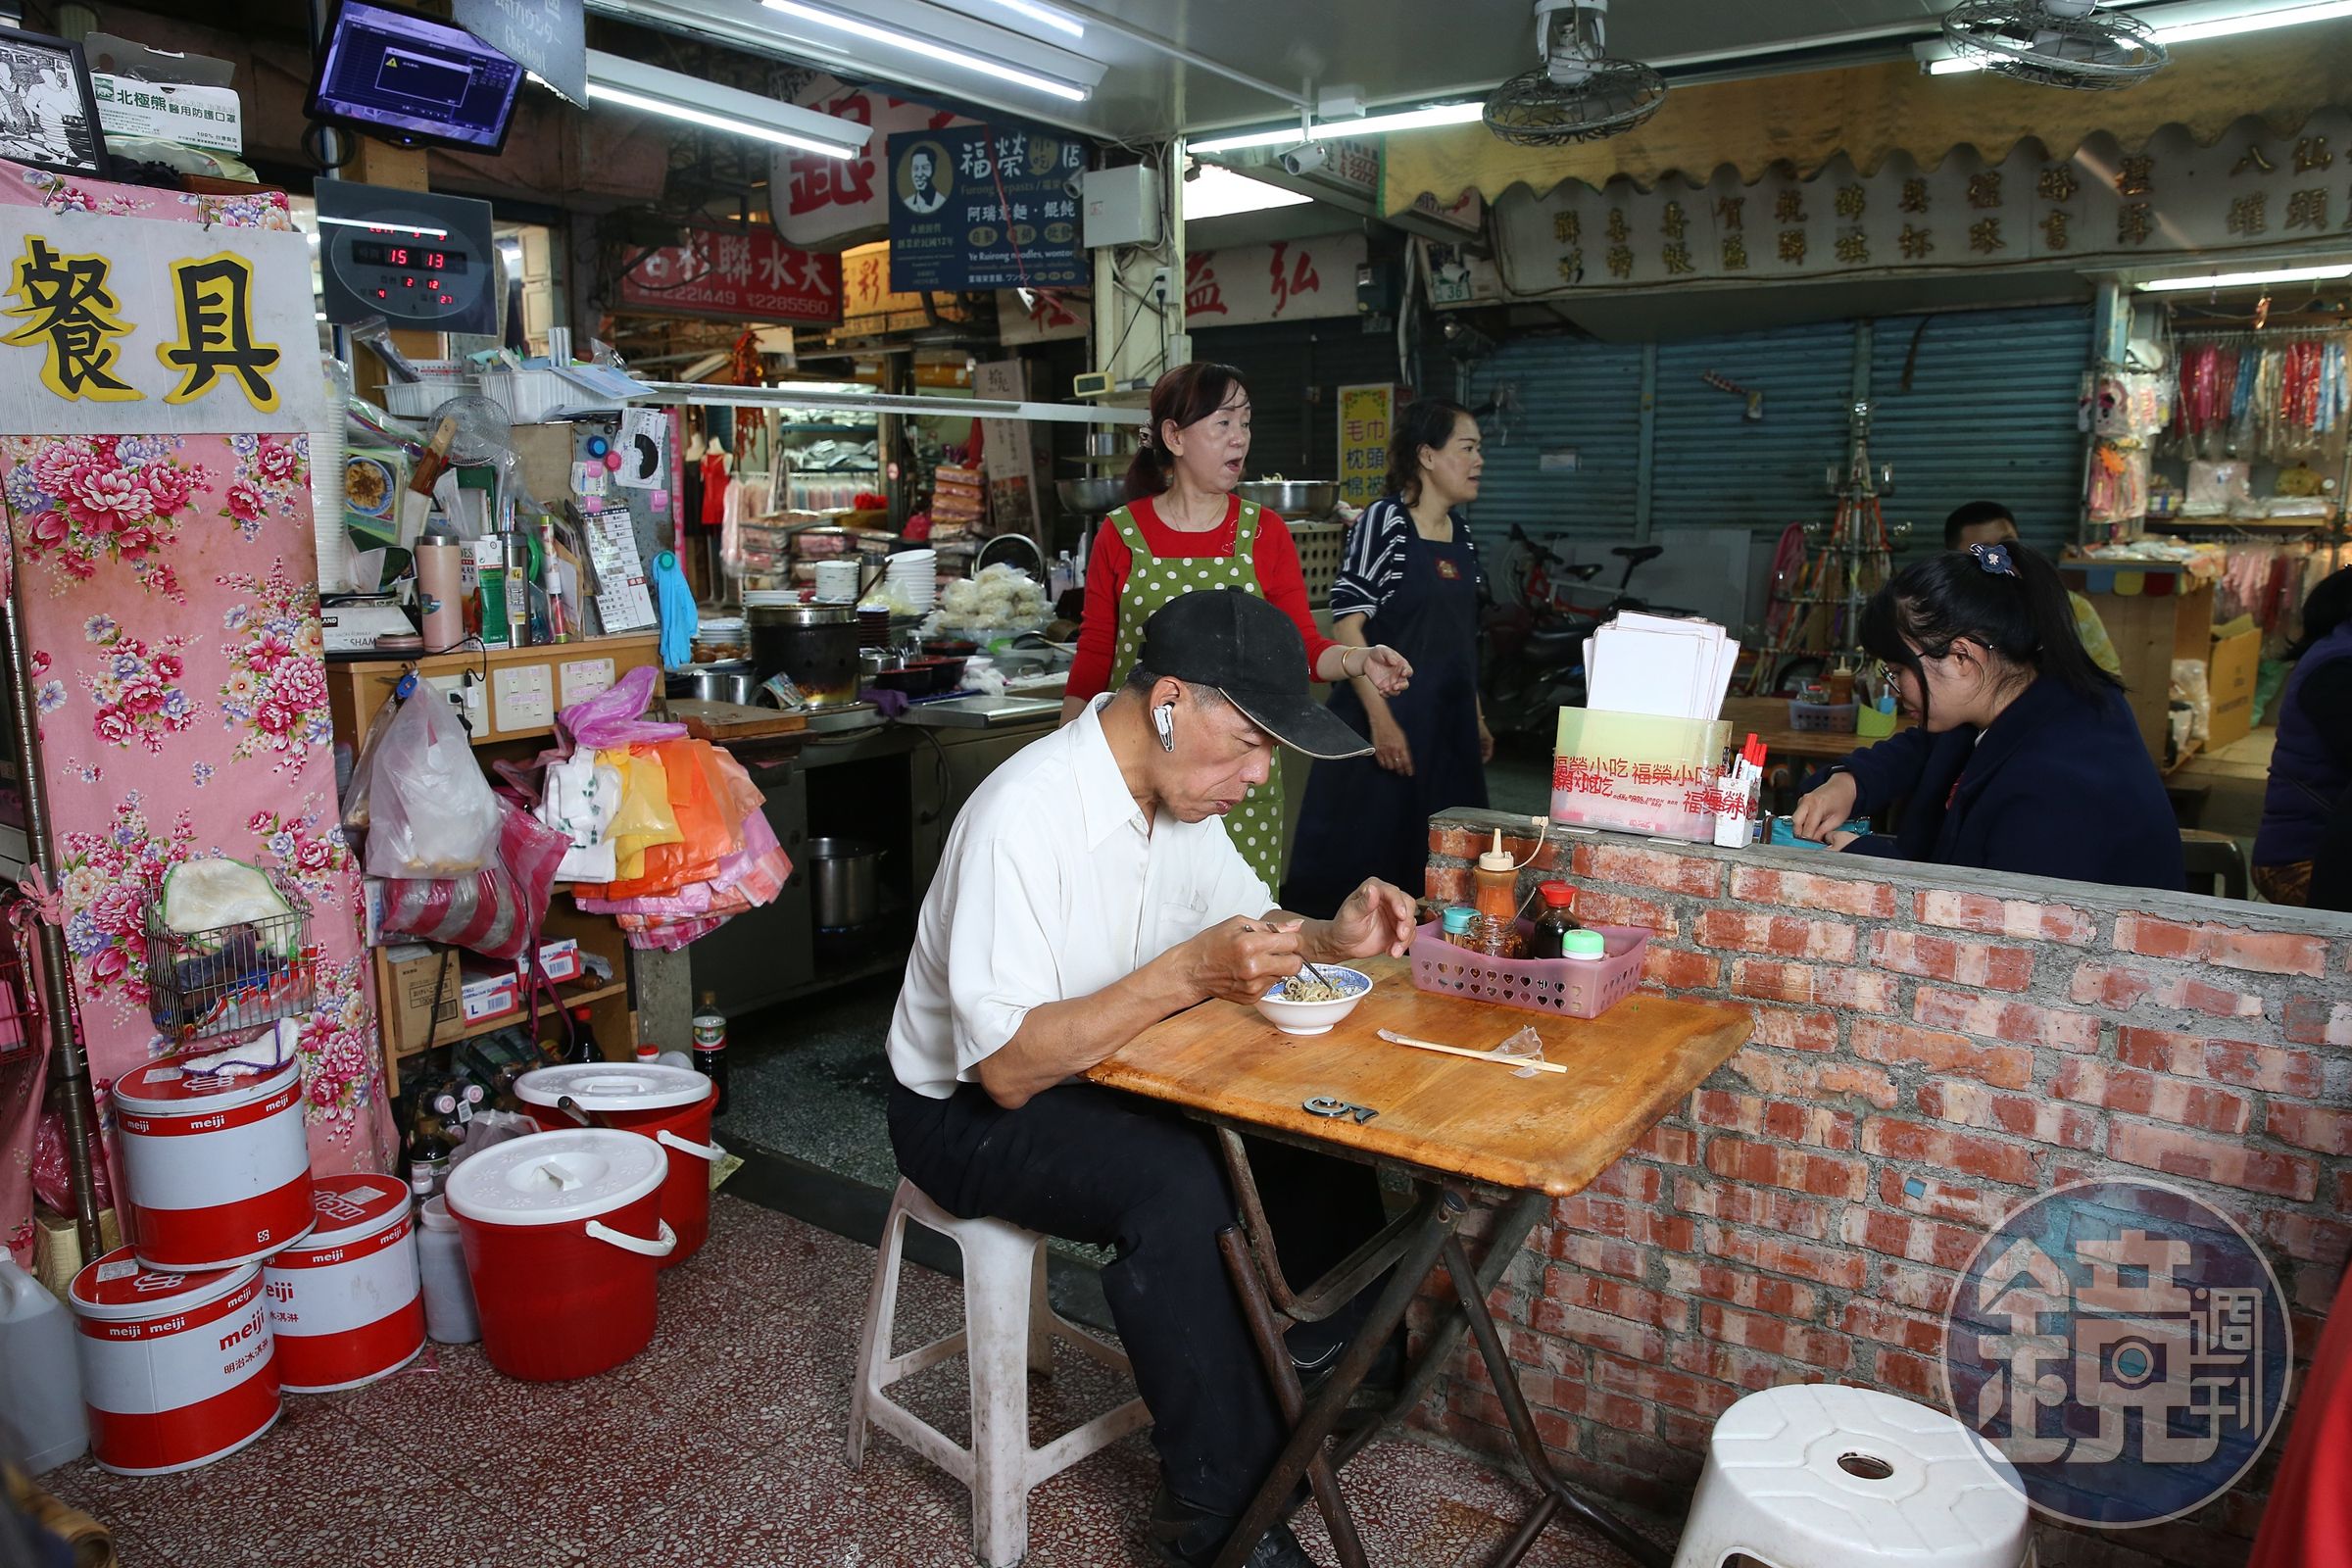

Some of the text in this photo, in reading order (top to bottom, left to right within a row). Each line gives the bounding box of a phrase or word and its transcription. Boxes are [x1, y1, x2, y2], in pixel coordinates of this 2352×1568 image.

[117, 89, 167, 112] 北極熊
[169, 103, 236, 124] 醫用防護口罩
[960, 133, 1027, 178] 福榮
[391, 249, 445, 270] 15 13
[406, 277, 440, 290] 2 12
[377, 289, 454, 305] 4 27
[2, 236, 282, 413] 餐具
[1347, 419, 1386, 443] 毛巾
[1346, 448, 1385, 469] 枕頭
[470, 1004, 479, 1015] L
[127, 1093, 289, 1133] meiji meiji meiji
[312, 1249, 344, 1263] meiji
[379, 1225, 403, 1246] meiji
[266, 1281, 294, 1303] eiji
[109, 1286, 252, 1338] meiji meiji meiji
[219, 1305, 265, 1351] meiji
